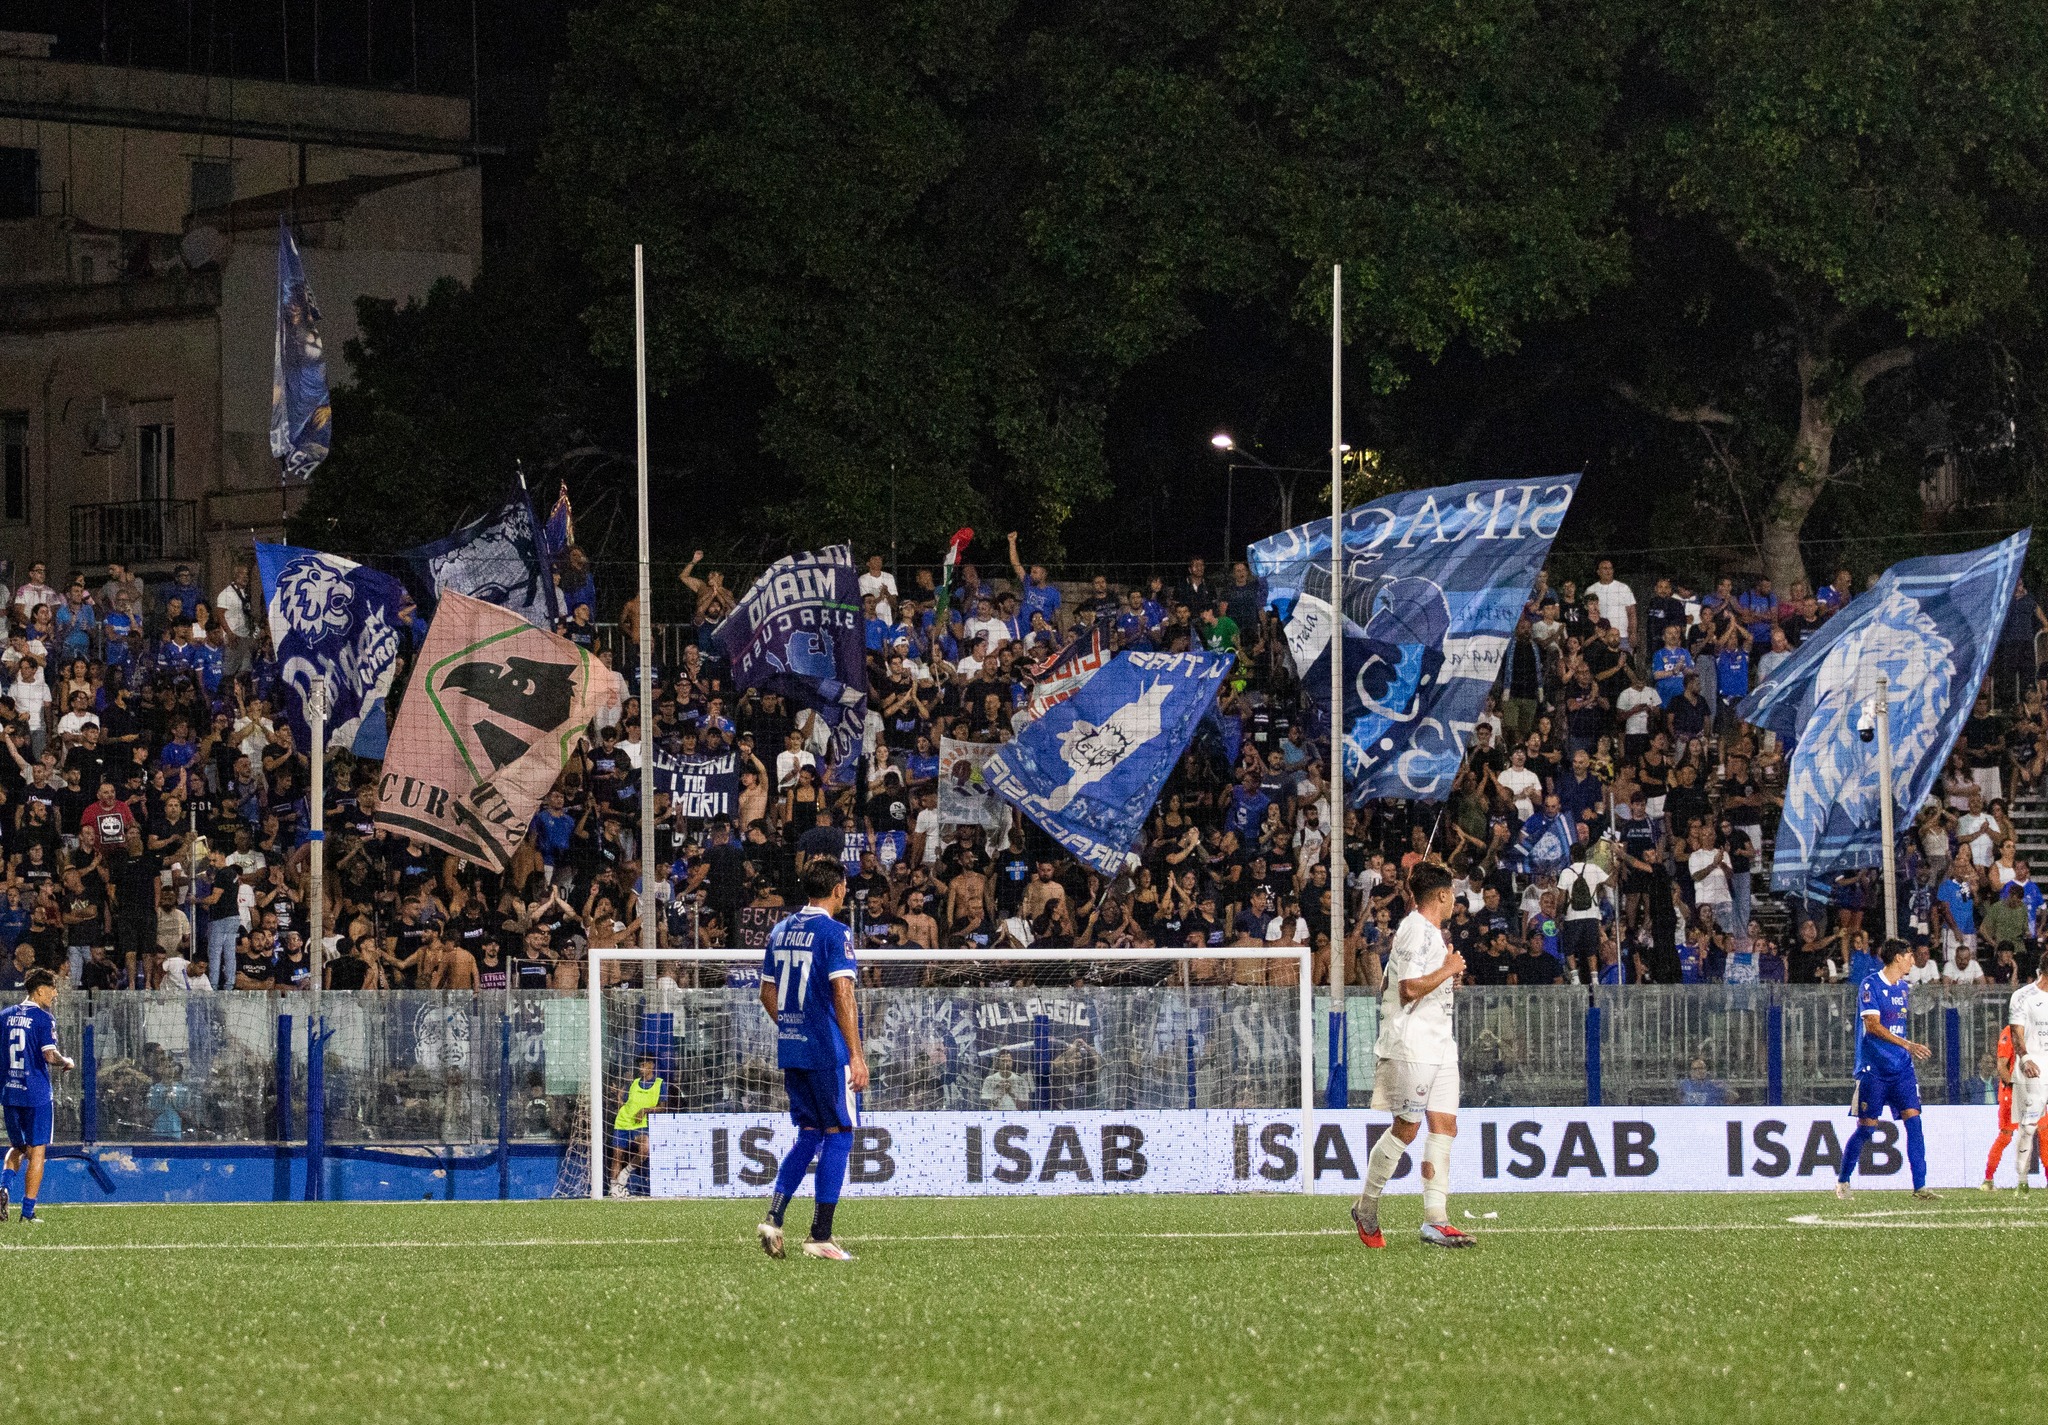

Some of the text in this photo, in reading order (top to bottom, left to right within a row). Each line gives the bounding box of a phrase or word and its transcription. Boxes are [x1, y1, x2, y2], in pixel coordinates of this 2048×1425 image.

[682, 775, 707, 793] TIA
[742, 907, 791, 926] SEN
[784, 931, 815, 947] PAOLO
[773, 949, 814, 1011] 77
[9, 1028, 26, 1070] 2
[712, 1126, 896, 1187] ISB
[965, 1124, 1148, 1184] ISAB
[1481, 1119, 1660, 1180] ISAB
[1726, 1119, 1904, 1178] ISAB
